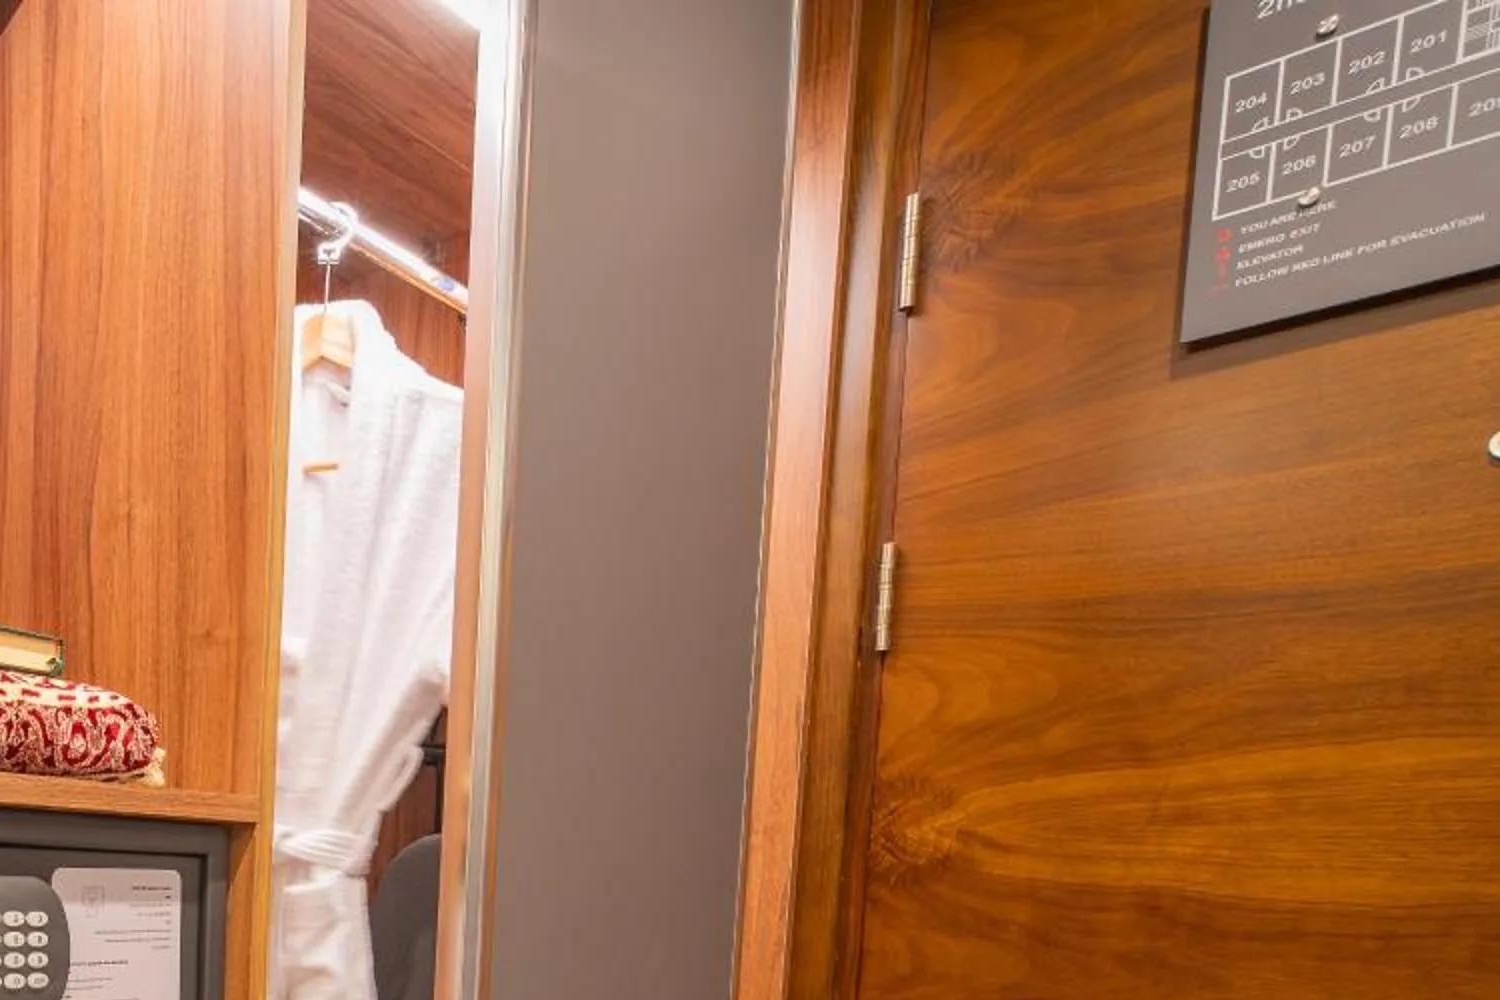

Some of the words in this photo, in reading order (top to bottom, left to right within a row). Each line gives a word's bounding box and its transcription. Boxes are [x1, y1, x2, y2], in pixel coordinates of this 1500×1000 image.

[1410, 29, 1448, 53] 201
[1348, 51, 1387, 75] 202
[1289, 72, 1326, 95] 203
[1235, 92, 1268, 113] 204
[1398, 116, 1439, 139] 208
[1338, 135, 1377, 158] 207
[1282, 154, 1317, 176] 206
[1224, 172, 1261, 193] 205
